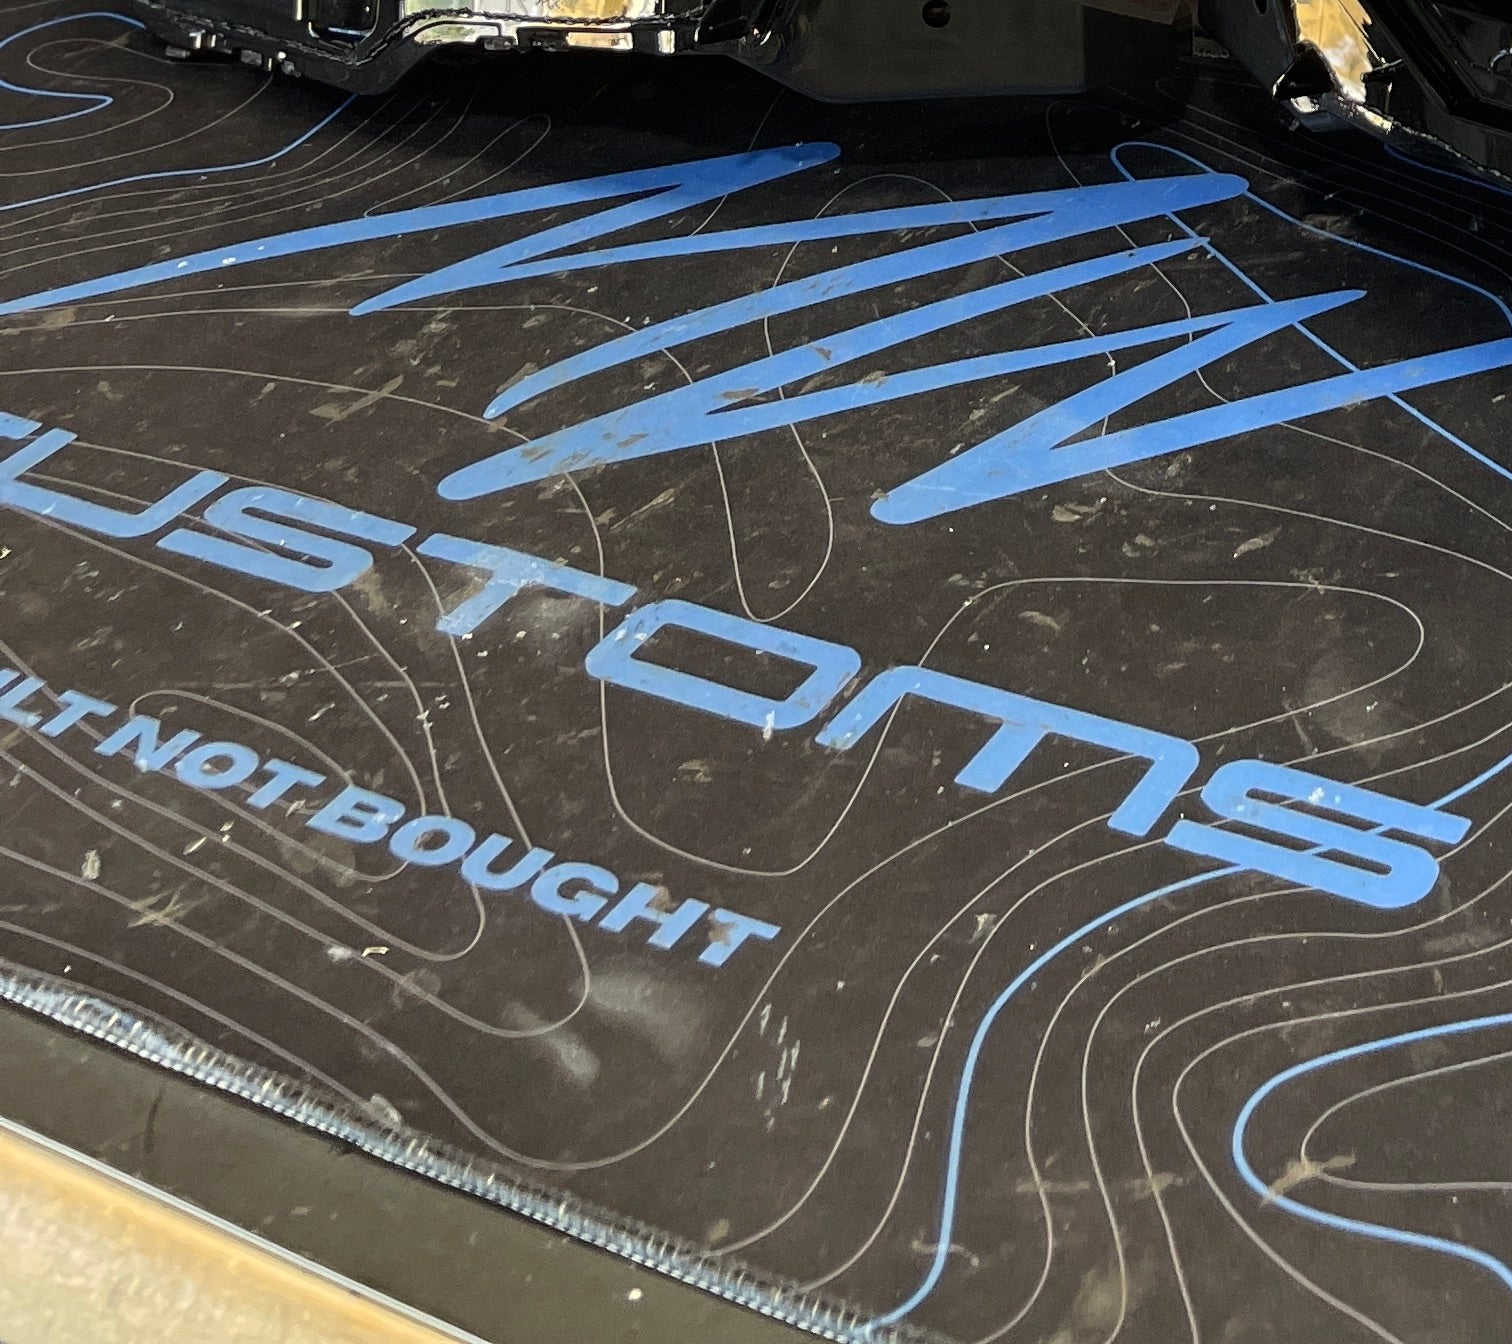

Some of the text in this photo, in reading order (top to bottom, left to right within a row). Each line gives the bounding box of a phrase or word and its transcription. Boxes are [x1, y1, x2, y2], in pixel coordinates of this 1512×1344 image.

[0, 412, 1471, 910] USTOMS
[94, 714, 326, 810] NOT
[306, 782, 782, 968] BOUGHT
